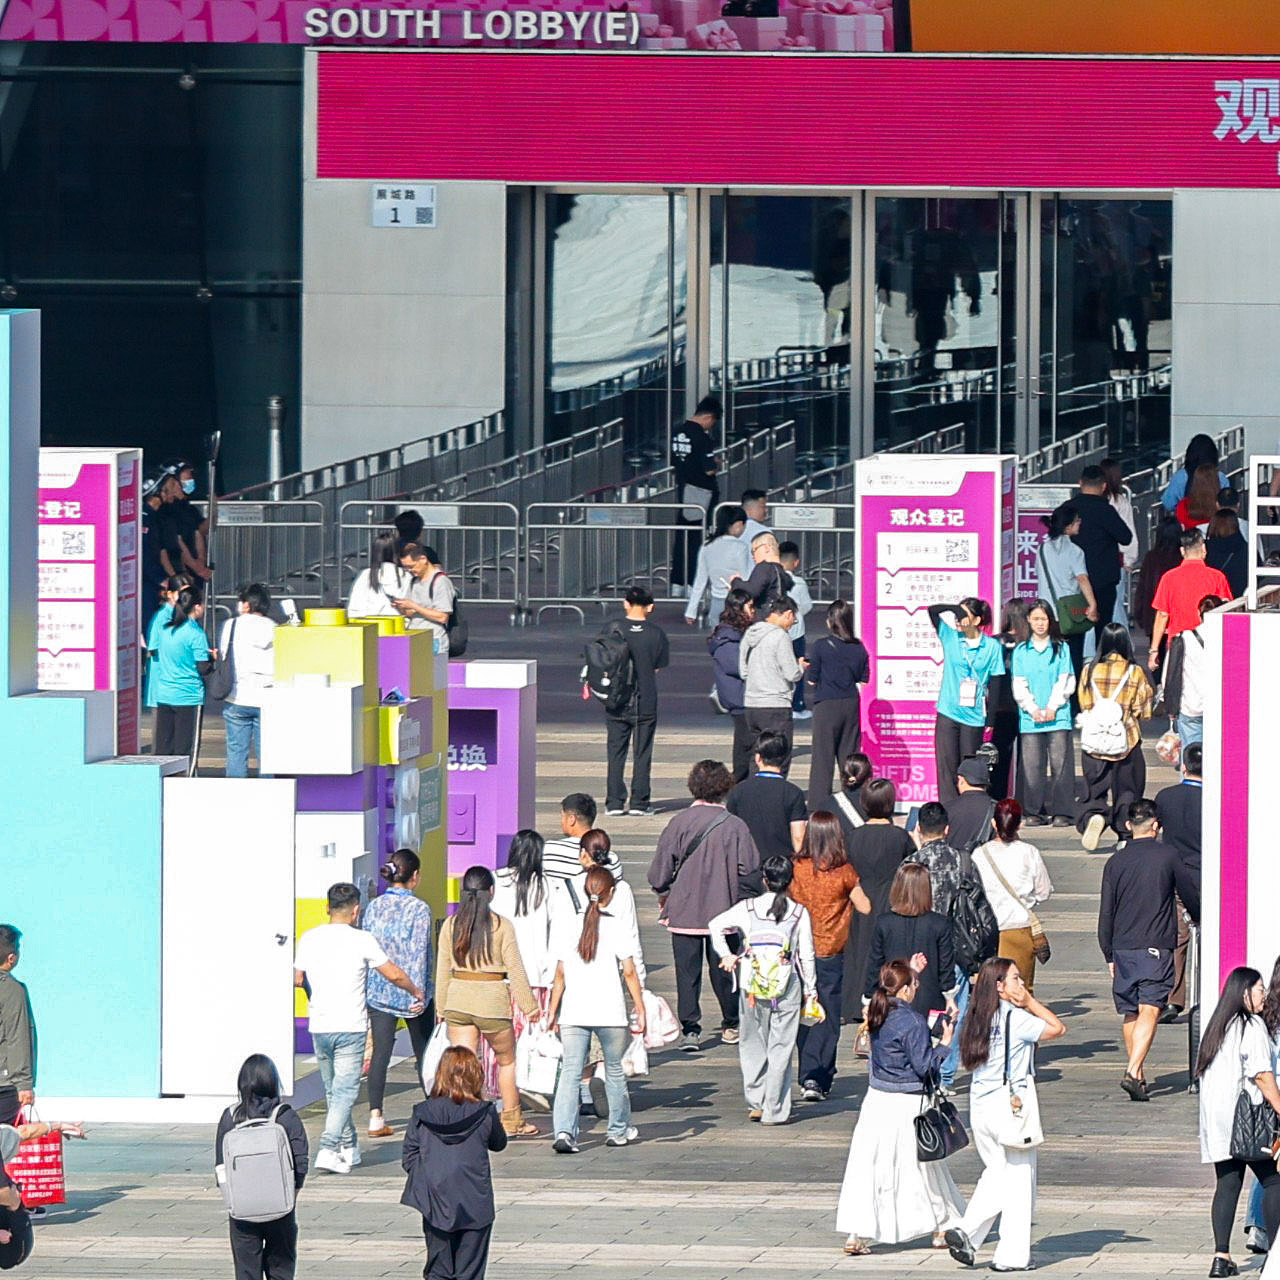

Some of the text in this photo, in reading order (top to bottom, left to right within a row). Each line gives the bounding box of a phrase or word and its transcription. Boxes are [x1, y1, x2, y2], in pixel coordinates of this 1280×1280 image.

[304, 8, 640, 46] SOUTH LOBBY(E)
[390, 206, 401, 224] 1
[38, 500, 81, 519] 登记
[889, 508, 965, 527] 观众登记
[884, 582, 893, 595] 2
[884, 626, 893, 640] 3
[884, 673, 894, 686] 4
[897, 783, 939, 801] OME
